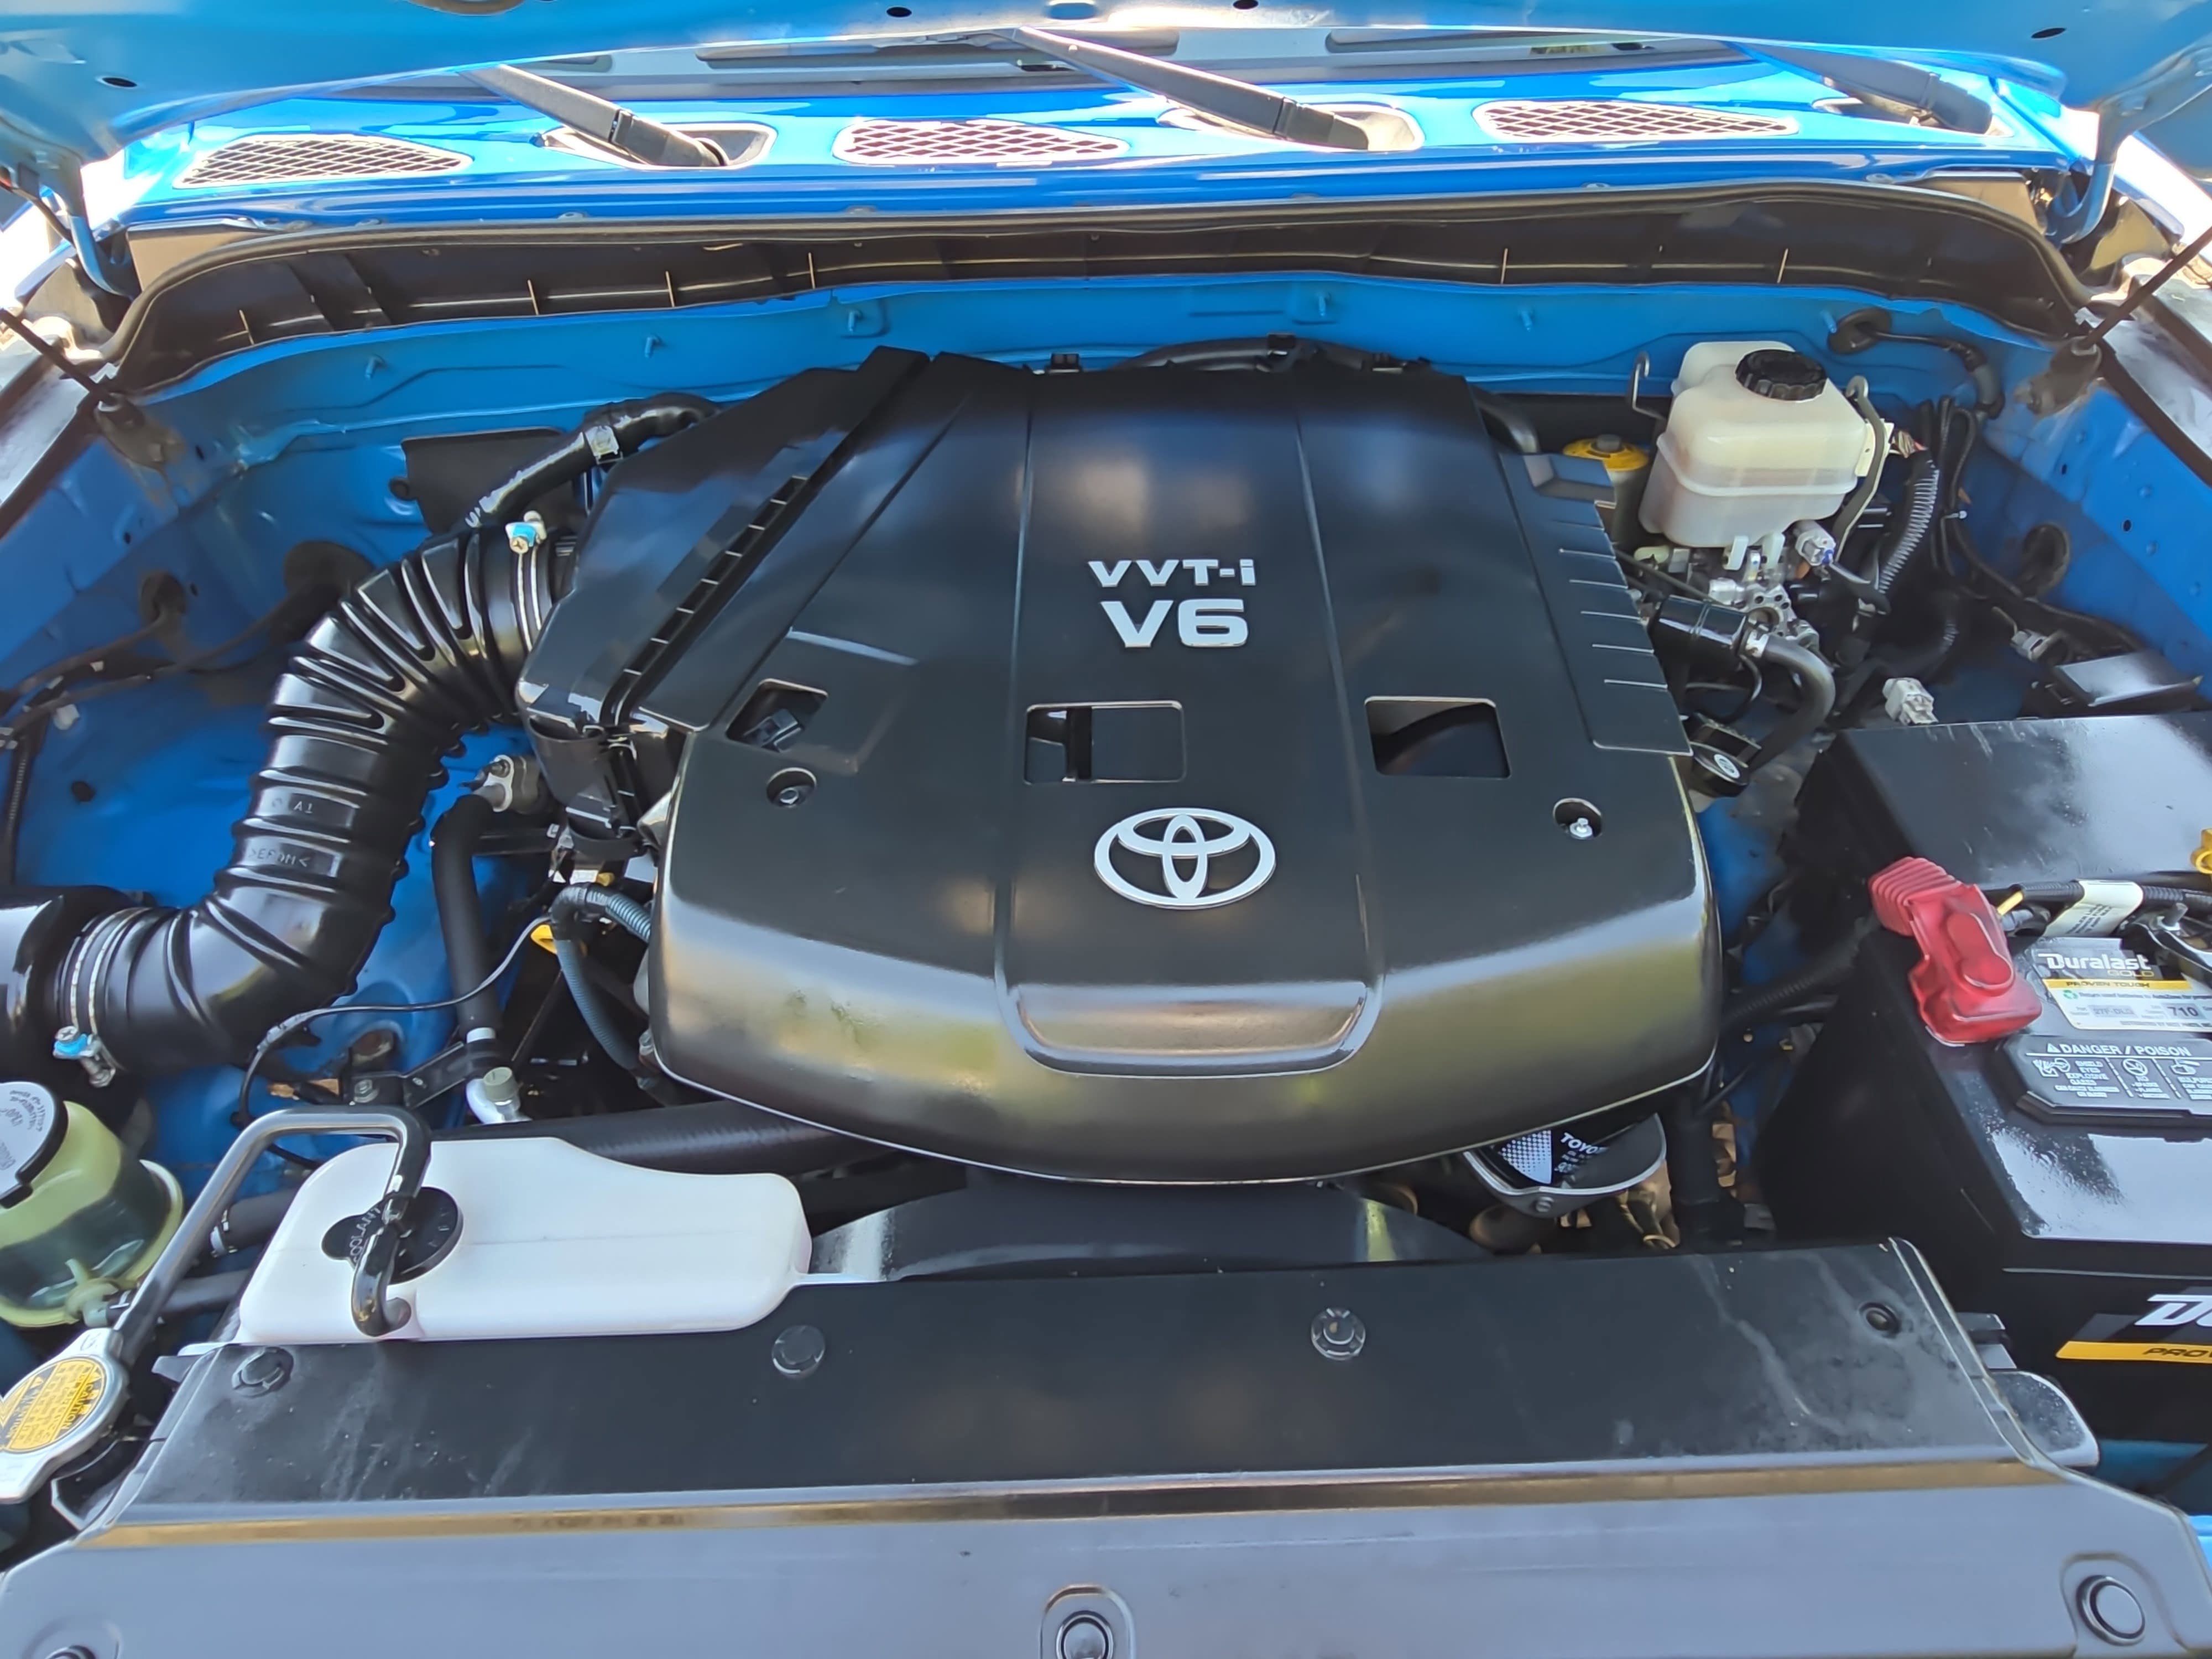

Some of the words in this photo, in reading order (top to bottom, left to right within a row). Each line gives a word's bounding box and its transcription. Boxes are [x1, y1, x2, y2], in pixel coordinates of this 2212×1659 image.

[1088, 559, 1256, 587] VVT-i
[1100, 598, 1248, 648] V6
[2038, 953, 2152, 969] Duralast
[2167, 1006, 2199, 1017] 710
[2059, 1044, 2123, 1055] DANGER
[2133, 1046, 2192, 1056] POISON
[2143, 1348, 2212, 1358] PRO
